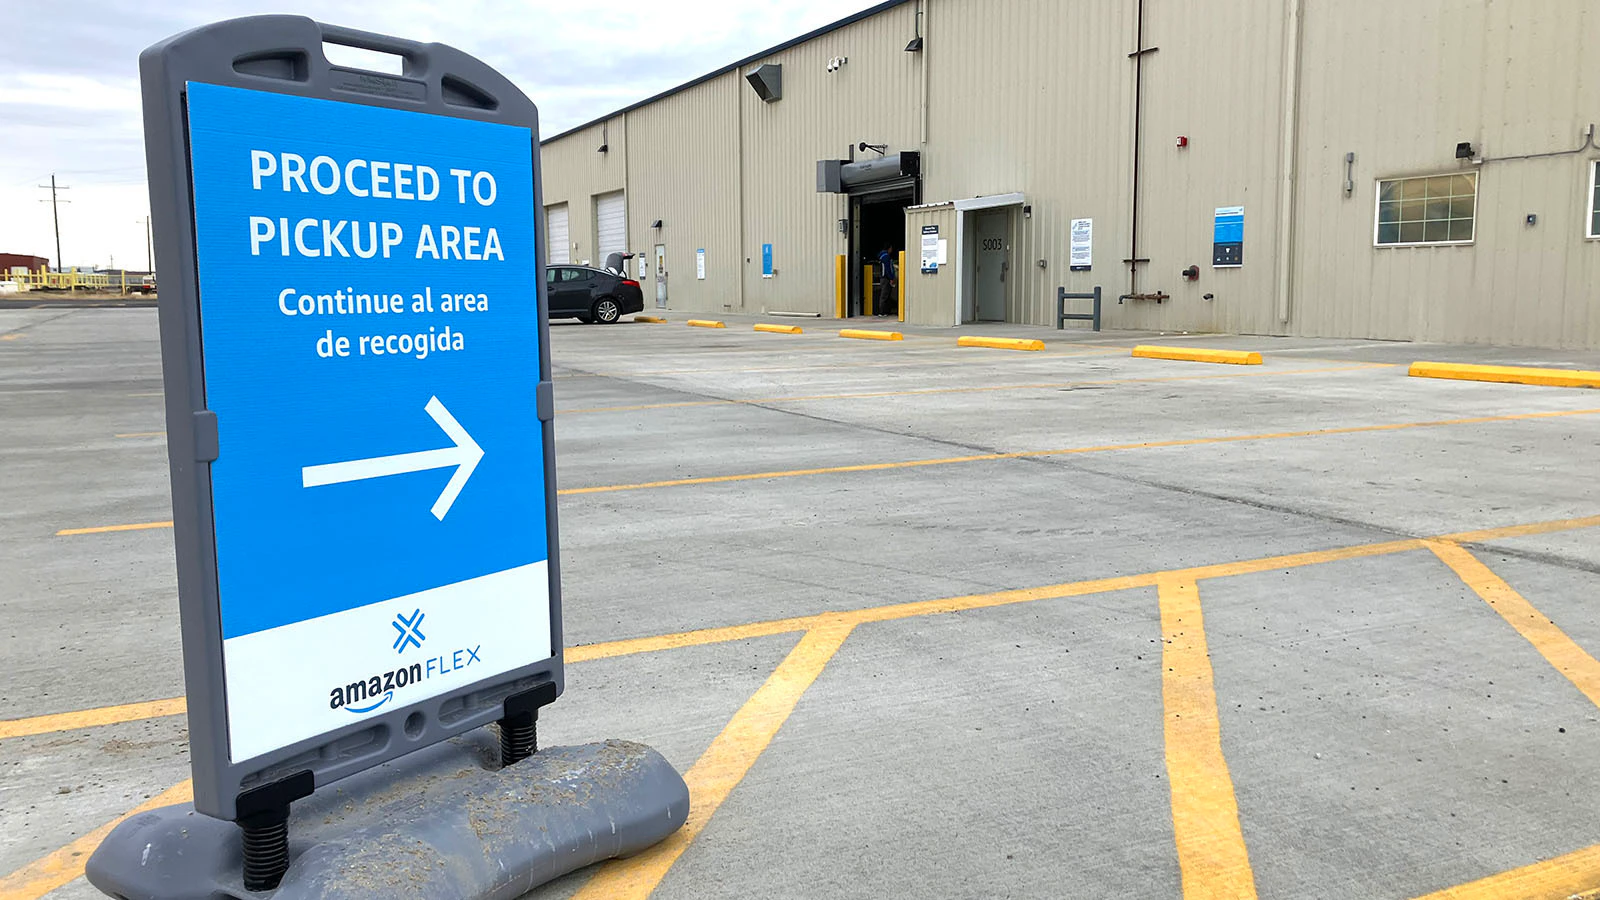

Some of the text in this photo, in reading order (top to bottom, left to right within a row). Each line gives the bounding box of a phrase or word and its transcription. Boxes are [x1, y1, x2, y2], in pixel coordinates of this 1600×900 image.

[250, 149, 497, 206] PROCEED TO
[249, 216, 505, 261] PICKUP AREA
[278, 286, 489, 316] Continue al area
[316, 325, 465, 360] de recogida
[330, 645, 481, 710] amazon FLEX
